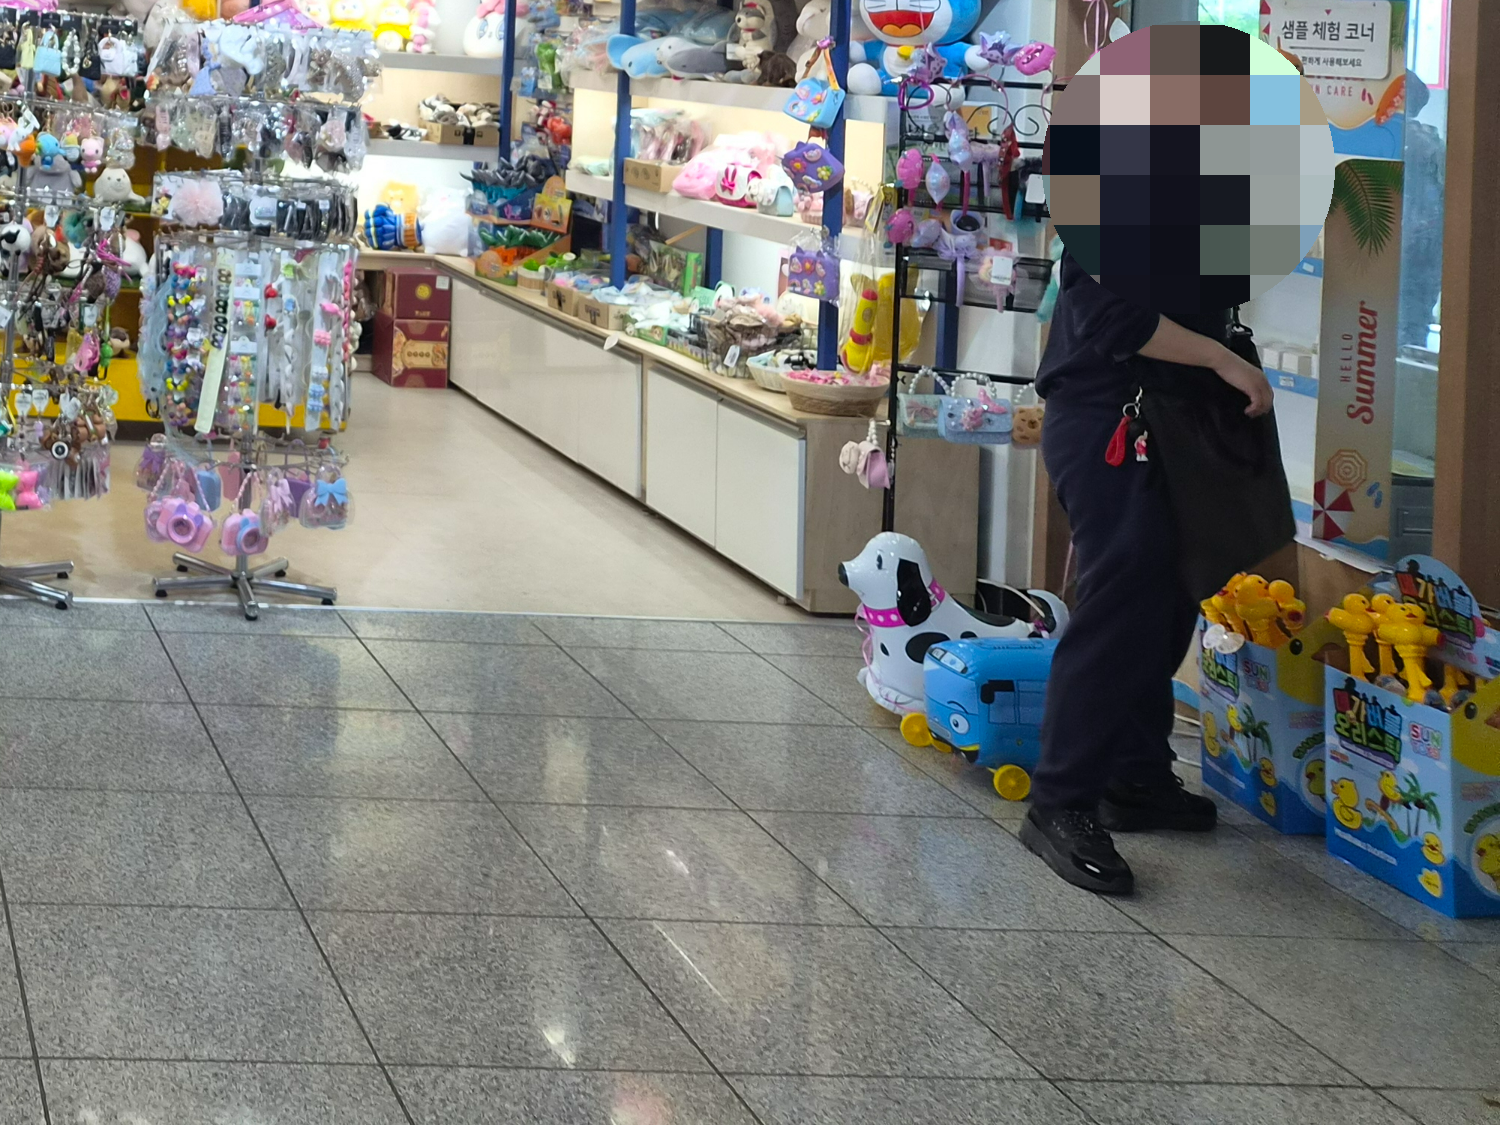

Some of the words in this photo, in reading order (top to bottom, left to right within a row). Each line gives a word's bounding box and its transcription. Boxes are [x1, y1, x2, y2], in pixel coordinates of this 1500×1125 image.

[1281, 20, 1309, 41] 샘플
[1312, 21, 1340, 41] 체험
[1344, 22, 1375, 42] 코너
[1322, 56, 1362, 67] 사용해보세요
[1327, 85, 1353, 97] CARE
[1340, 333, 1353, 382] HELLO
[1346, 300, 1378, 425] Summer
[1243, 658, 1271, 682] SUN
[1334, 713, 1402, 764] 오리스틱
[1409, 722, 1443, 750] SUN
